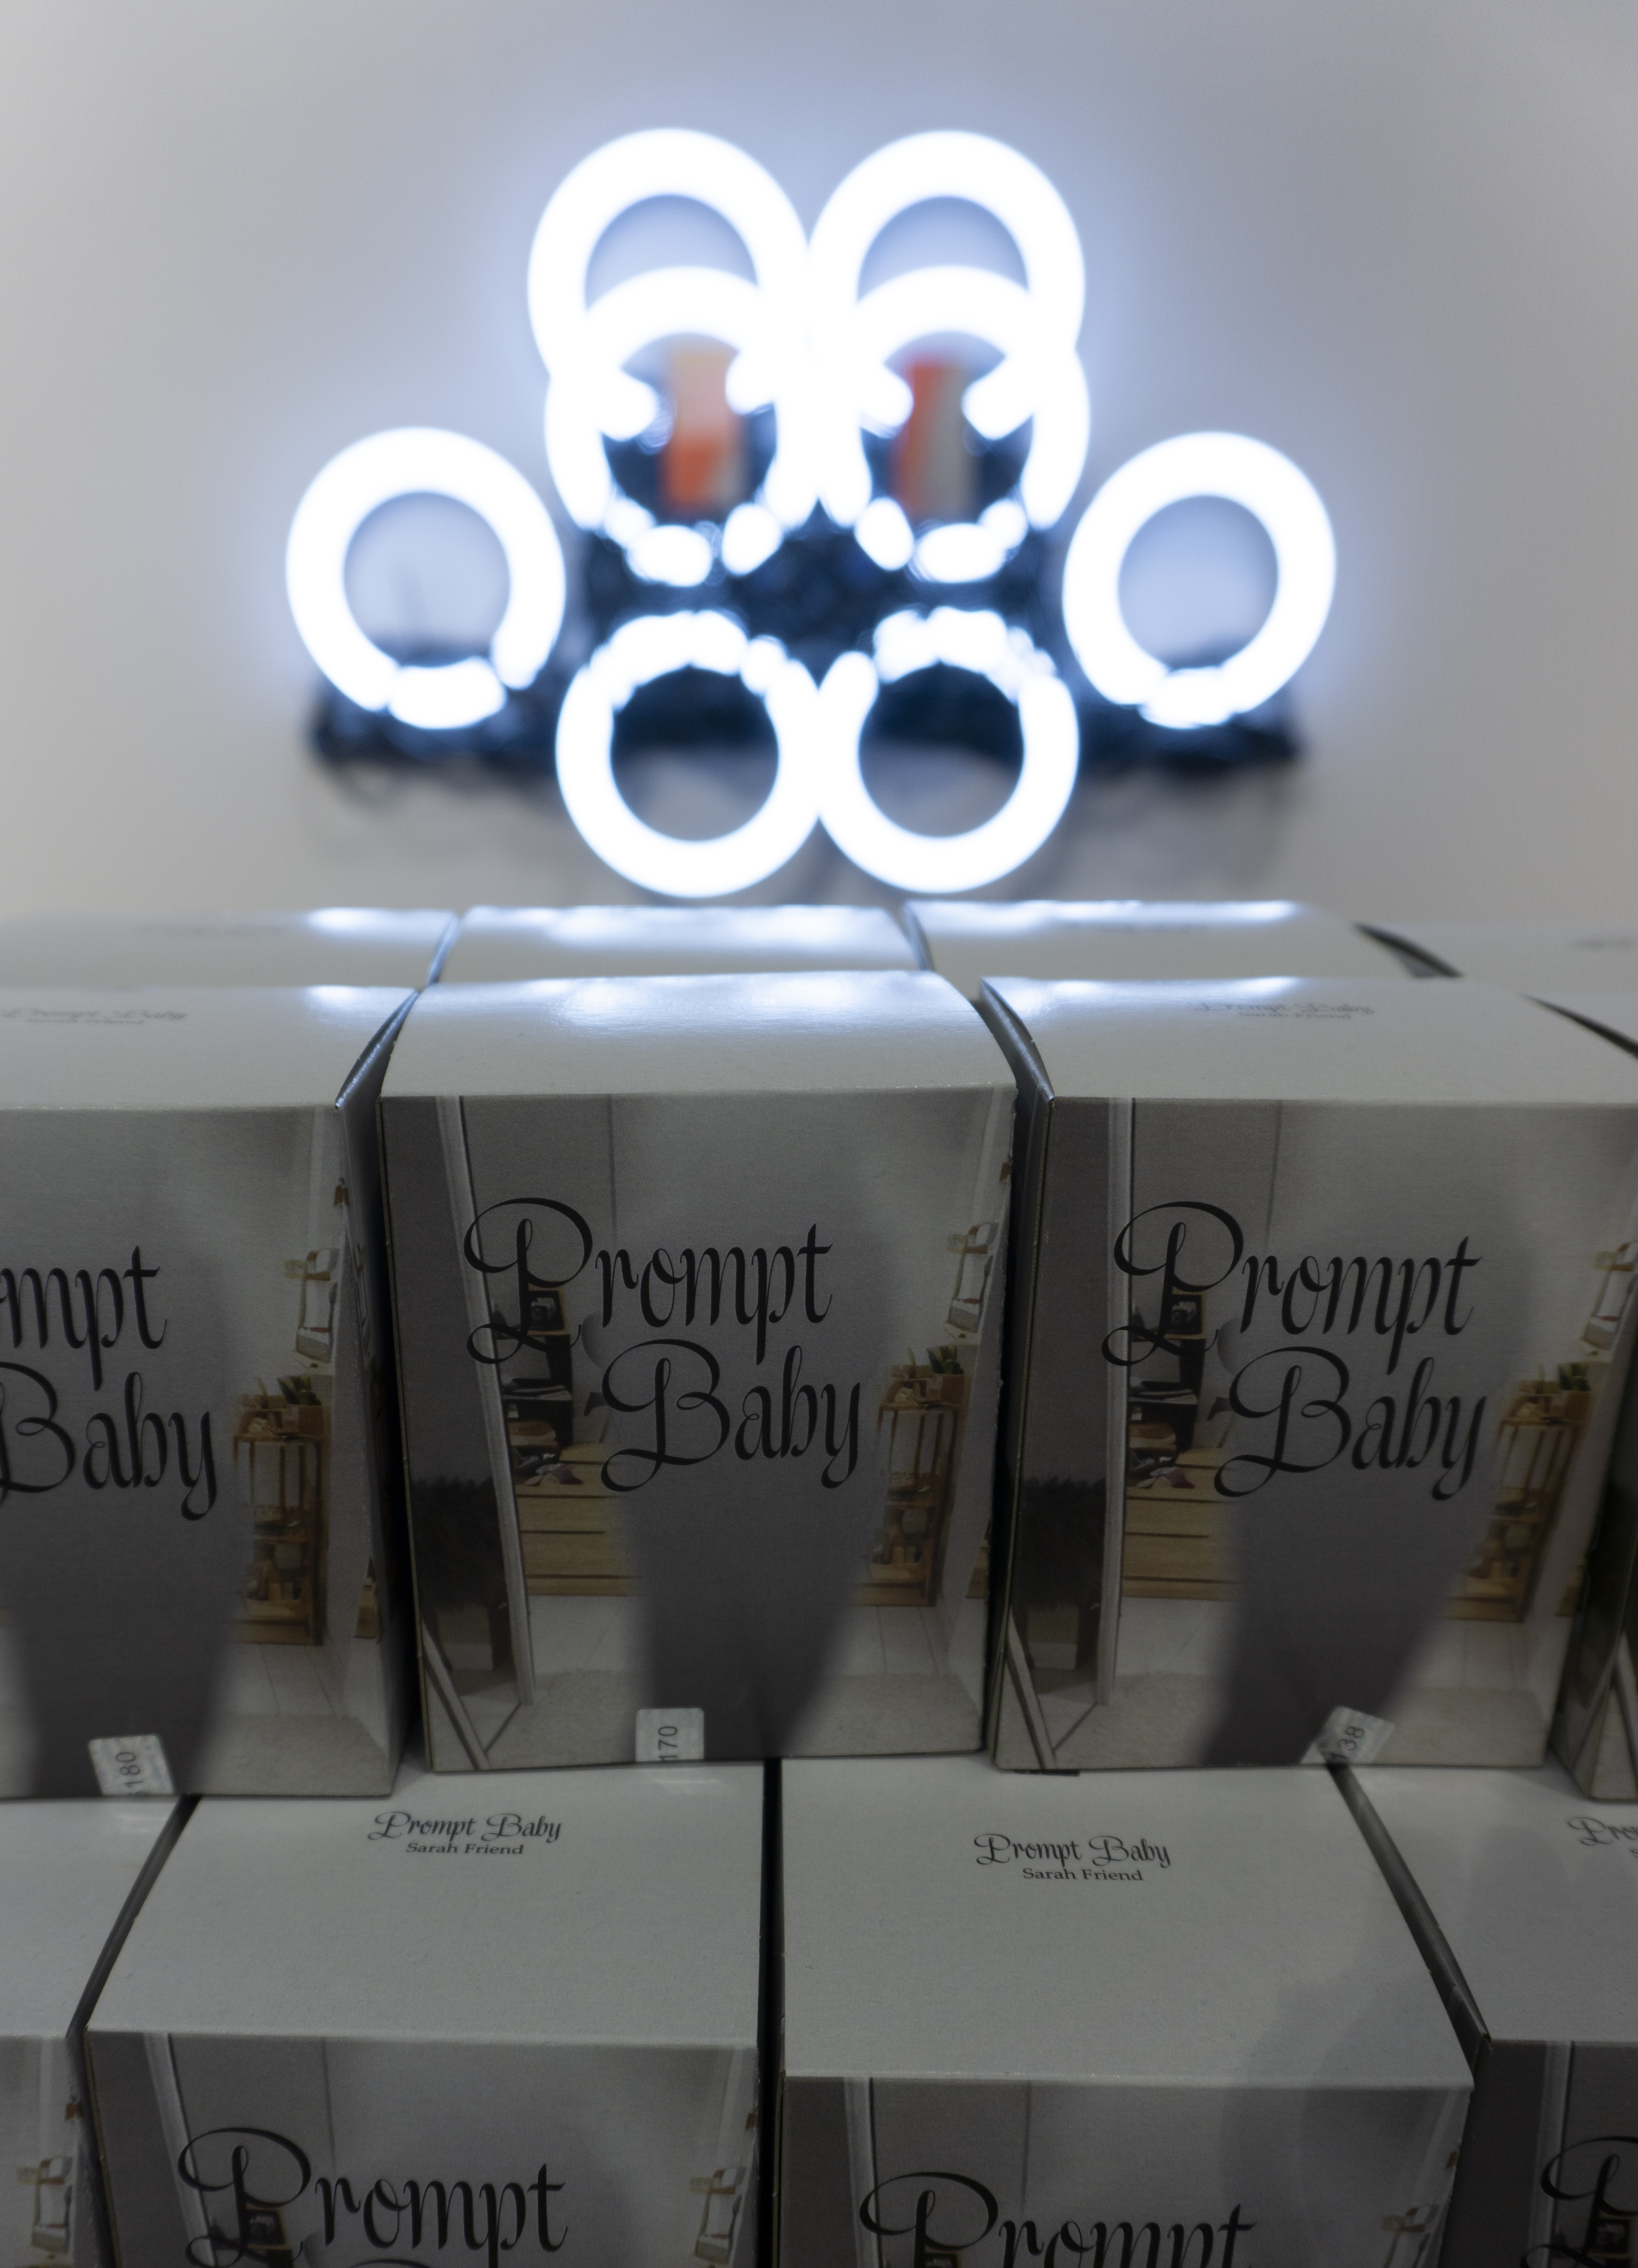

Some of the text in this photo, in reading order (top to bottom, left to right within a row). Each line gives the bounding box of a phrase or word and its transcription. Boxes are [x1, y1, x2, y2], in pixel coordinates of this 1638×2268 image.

[0, 1245, 167, 1392] mpt
[464, 1198, 833, 1365] Prompt
[1101, 1201, 1483, 1376] Prompt
[600, 1338, 860, 1492] Baby
[1214, 1346, 1487, 1501] Baby
[115, 1752, 148, 1796] 180
[658, 1725, 678, 1761] 170
[367, 1811, 562, 1844] Prompt Baby
[406, 1843, 525, 1855] Sarah Friend
[974, 1833, 1171, 1868] Prompt Baby
[1022, 1868, 1145, 1881] Sarah Friend
[178, 2127, 567, 2268] Prompt
